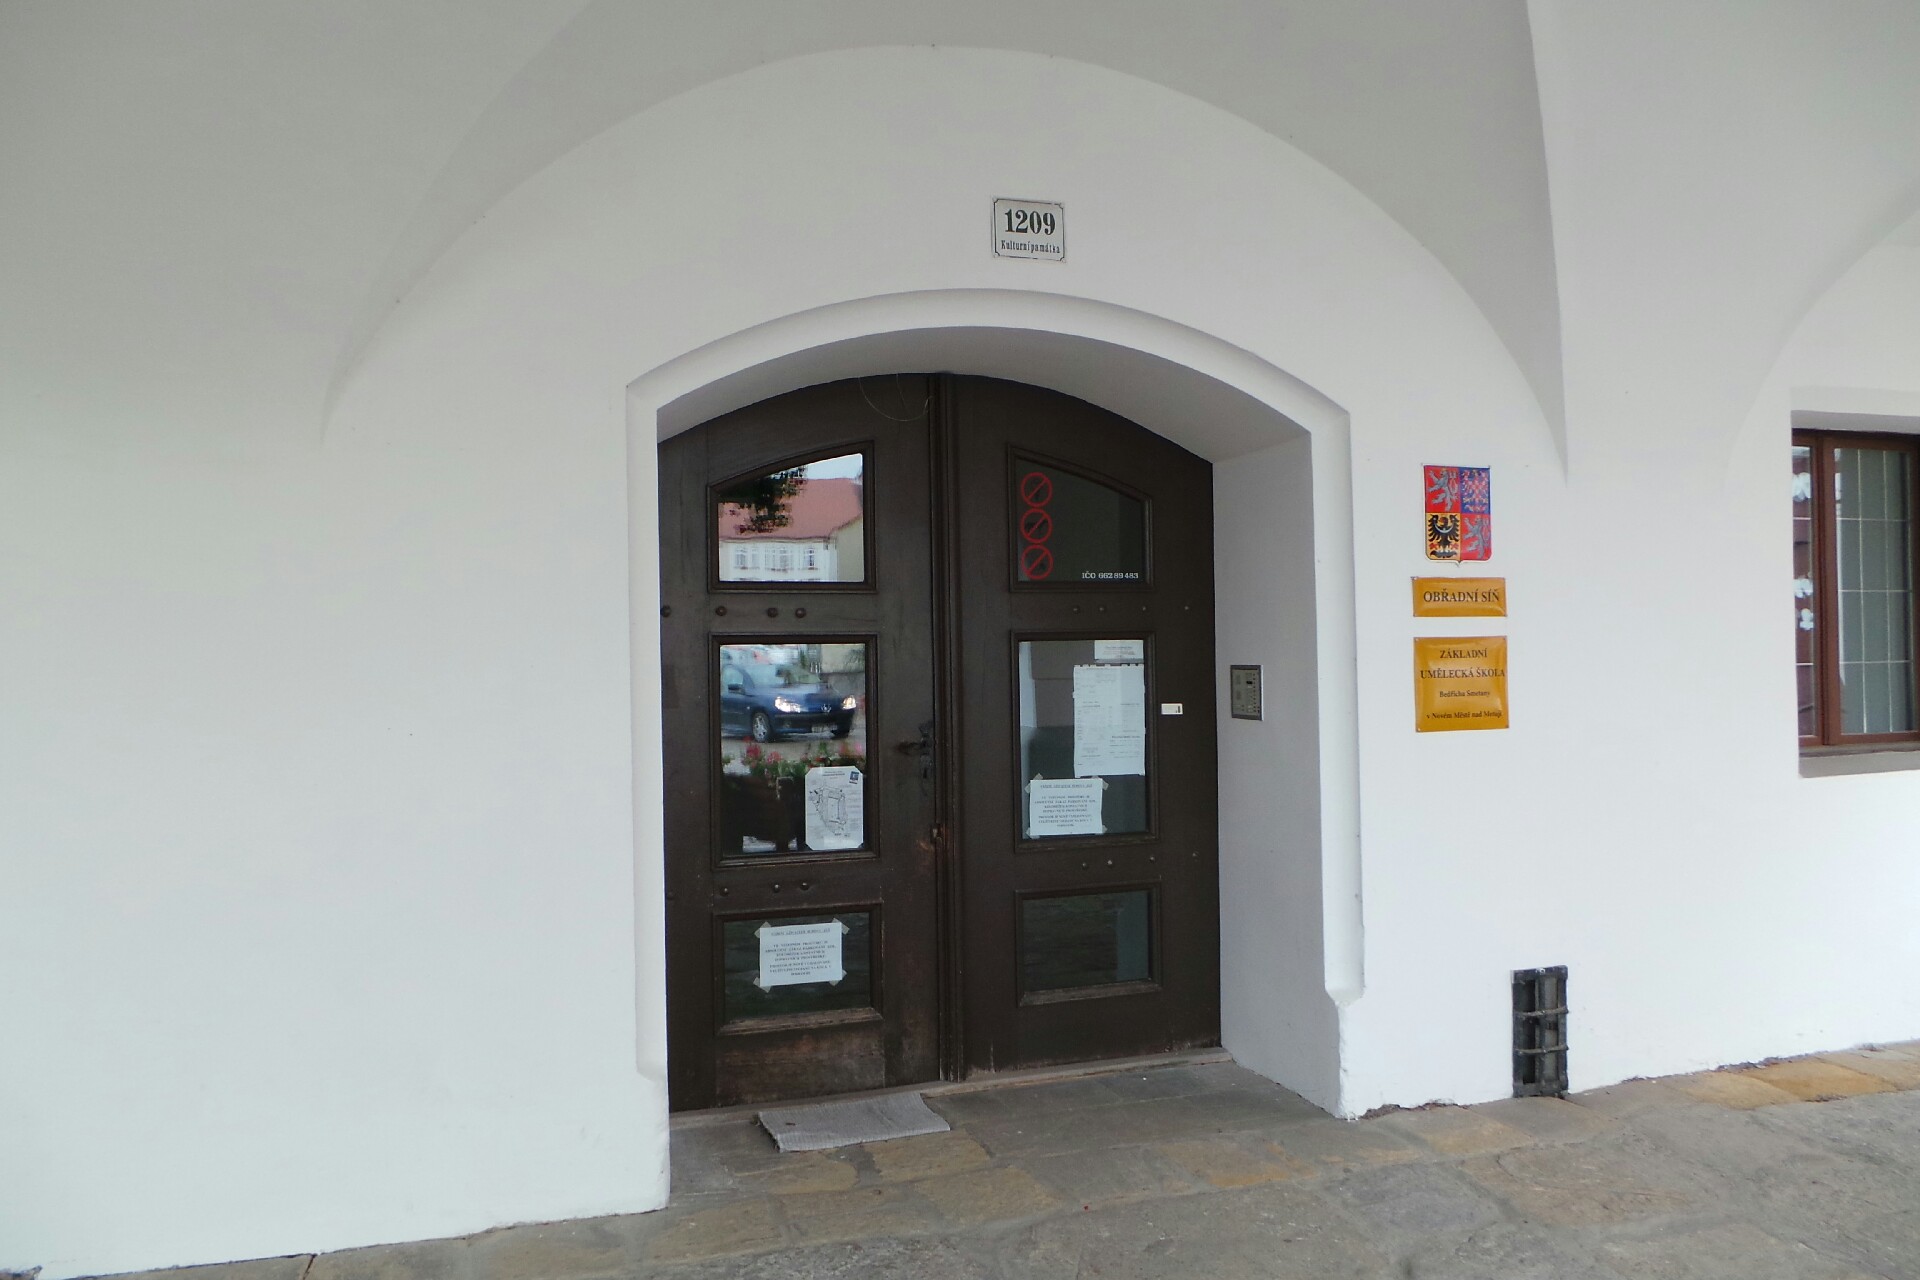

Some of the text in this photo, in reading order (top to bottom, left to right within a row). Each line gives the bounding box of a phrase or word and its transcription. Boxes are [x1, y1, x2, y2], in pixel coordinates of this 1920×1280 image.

[1004, 208, 1056, 236] 1209
[1001, 239, 1060, 254] Kulturní památka
[1081, 570, 1096, 579] IČO
[1423, 588, 1500, 602] OBŘADNÍ SÍŇ
[1439, 648, 1488, 659] ZÁKLADNÍ
[1420, 667, 1505, 679] UMĚLECKÁ ŠKOLA
[1466, 689, 1491, 698] Smetany
